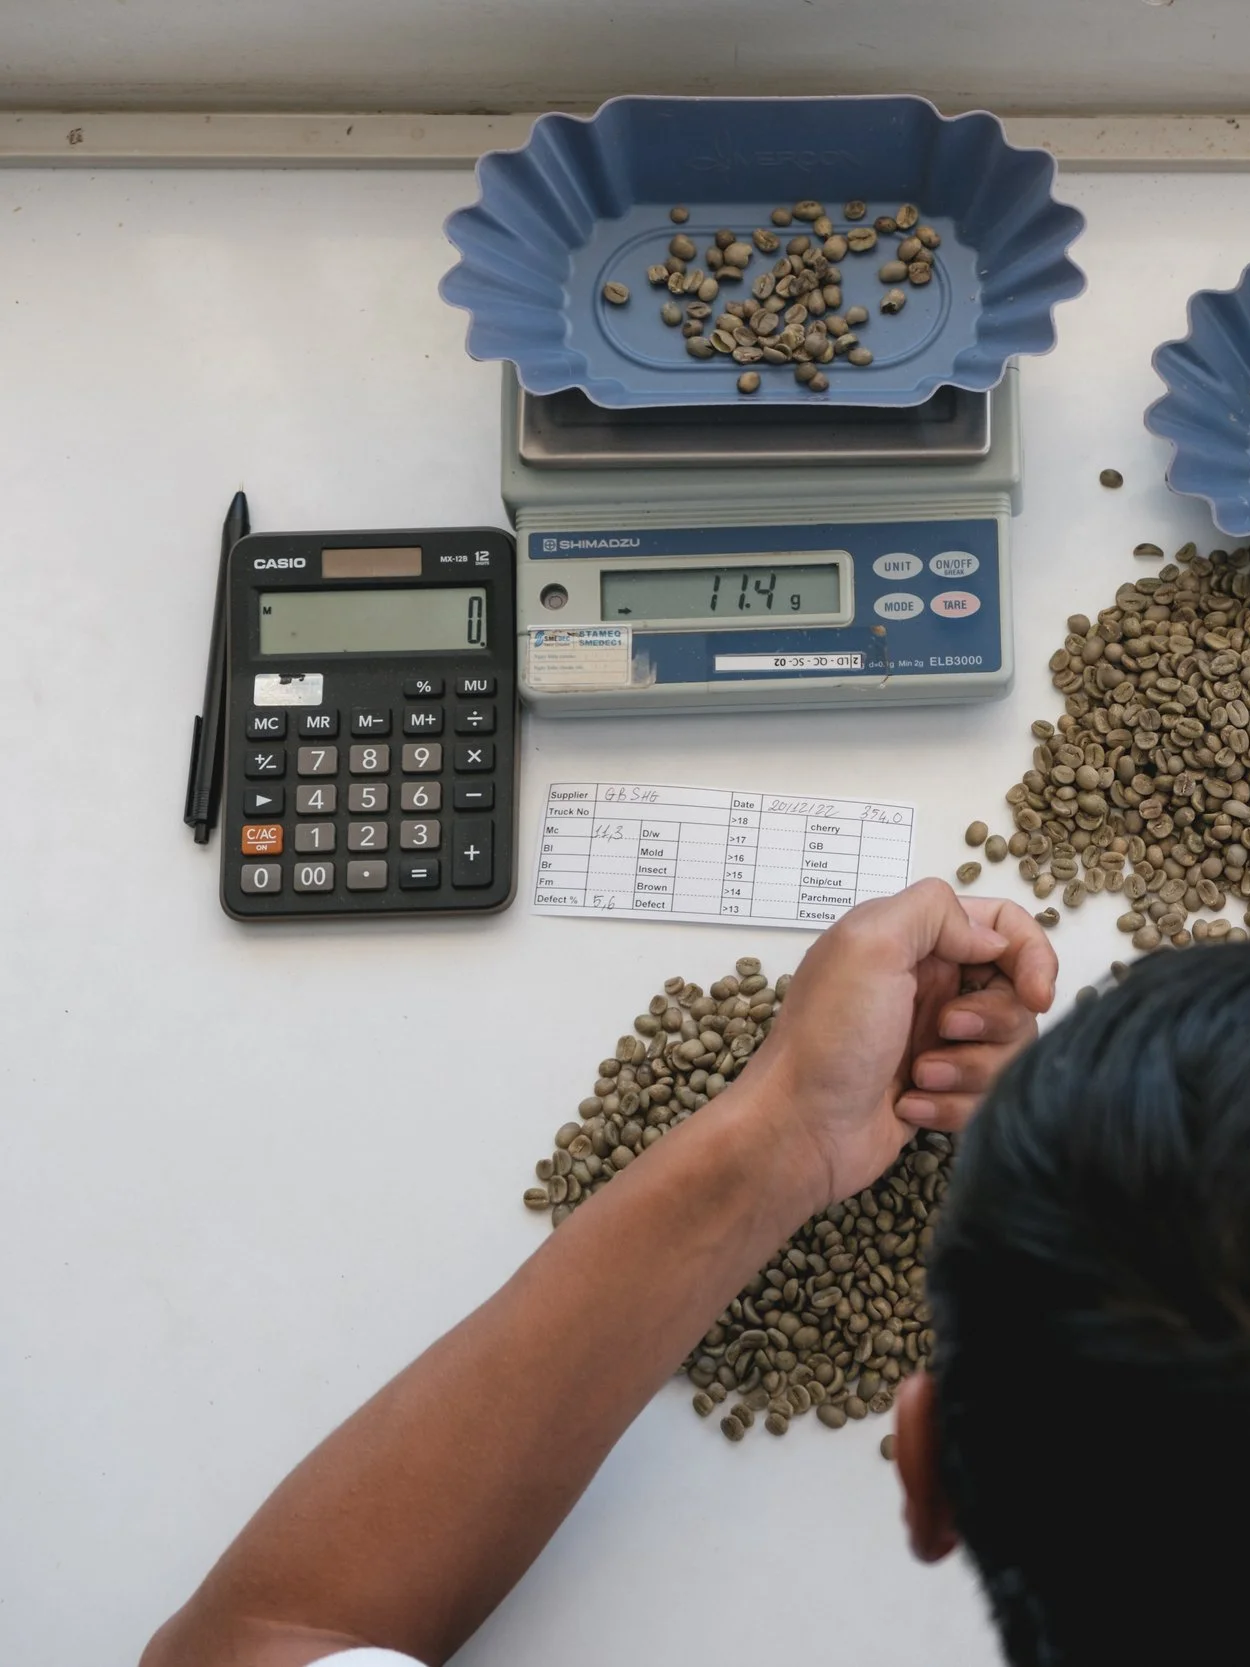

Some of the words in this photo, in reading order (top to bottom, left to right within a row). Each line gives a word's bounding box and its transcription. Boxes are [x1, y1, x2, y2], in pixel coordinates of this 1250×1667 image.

[559, 538, 641, 550] SHIMADZU
[440, 555, 468, 563] MX-12B
[475, 550, 490, 562] 12
[254, 557, 307, 570] CASIO
[884, 561, 912, 572] UNIT
[935, 559, 973, 570] ON/OFF
[710, 573, 777, 611] 11.4
[790, 594, 801, 611] g
[884, 601, 915, 612] MODE
[942, 600, 967, 610] TARE
[774, 658, 787, 667] 02
[914, 659, 924, 668] 2g
[930, 656, 983, 667] ELB3000
[416, 681, 431, 694] %
[464, 680, 487, 692] MU
[254, 717, 279, 731] MC
[307, 716, 330, 729] MR
[411, 713, 437, 726] M+
[310, 750, 326, 771] 7
[362, 748, 377, 769] 8
[414, 747, 430, 768] 9
[308, 788, 324, 809] 4
[361, 786, 376, 808] 5
[413, 785, 429, 806] 6
[550, 791, 588, 801] Supplier
[733, 800, 755, 809] Date
[549, 807, 574, 816] Truck
[577, 808, 590, 816] No
[731, 817, 749, 825] >18
[246, 827, 277, 841] C/AC
[413, 824, 428, 845] 3
[546, 826, 559, 835] Mc
[642, 829, 661, 838] D/w
[810, 824, 841, 835] cherry
[311, 827, 320, 847] 1
[360, 825, 376, 846] 2
[729, 836, 747, 844] >17
[256, 844, 268, 852] ON
[808, 842, 824, 851] GB
[640, 848, 664, 857] Mold
[727, 854, 745, 863] >16
[804, 859, 828, 869] Yield
[541, 861, 552, 869] Br
[638, 865, 668, 875] Insect
[254, 867, 269, 889] 0
[301, 866, 326, 886] 00
[726, 871, 743, 880] >15
[539, 878, 553, 886] Fm
[637, 882, 668, 892] Brown
[802, 876, 842, 887] Chip/cut
[724, 888, 741, 896] >14
[537, 894, 567, 904] Defect
[569, 895, 579, 905] %
[635, 899, 666, 909] Defect
[801, 893, 852, 905] Parchment
[722, 905, 740, 914] >13
[799, 910, 836, 921] Exselsa
